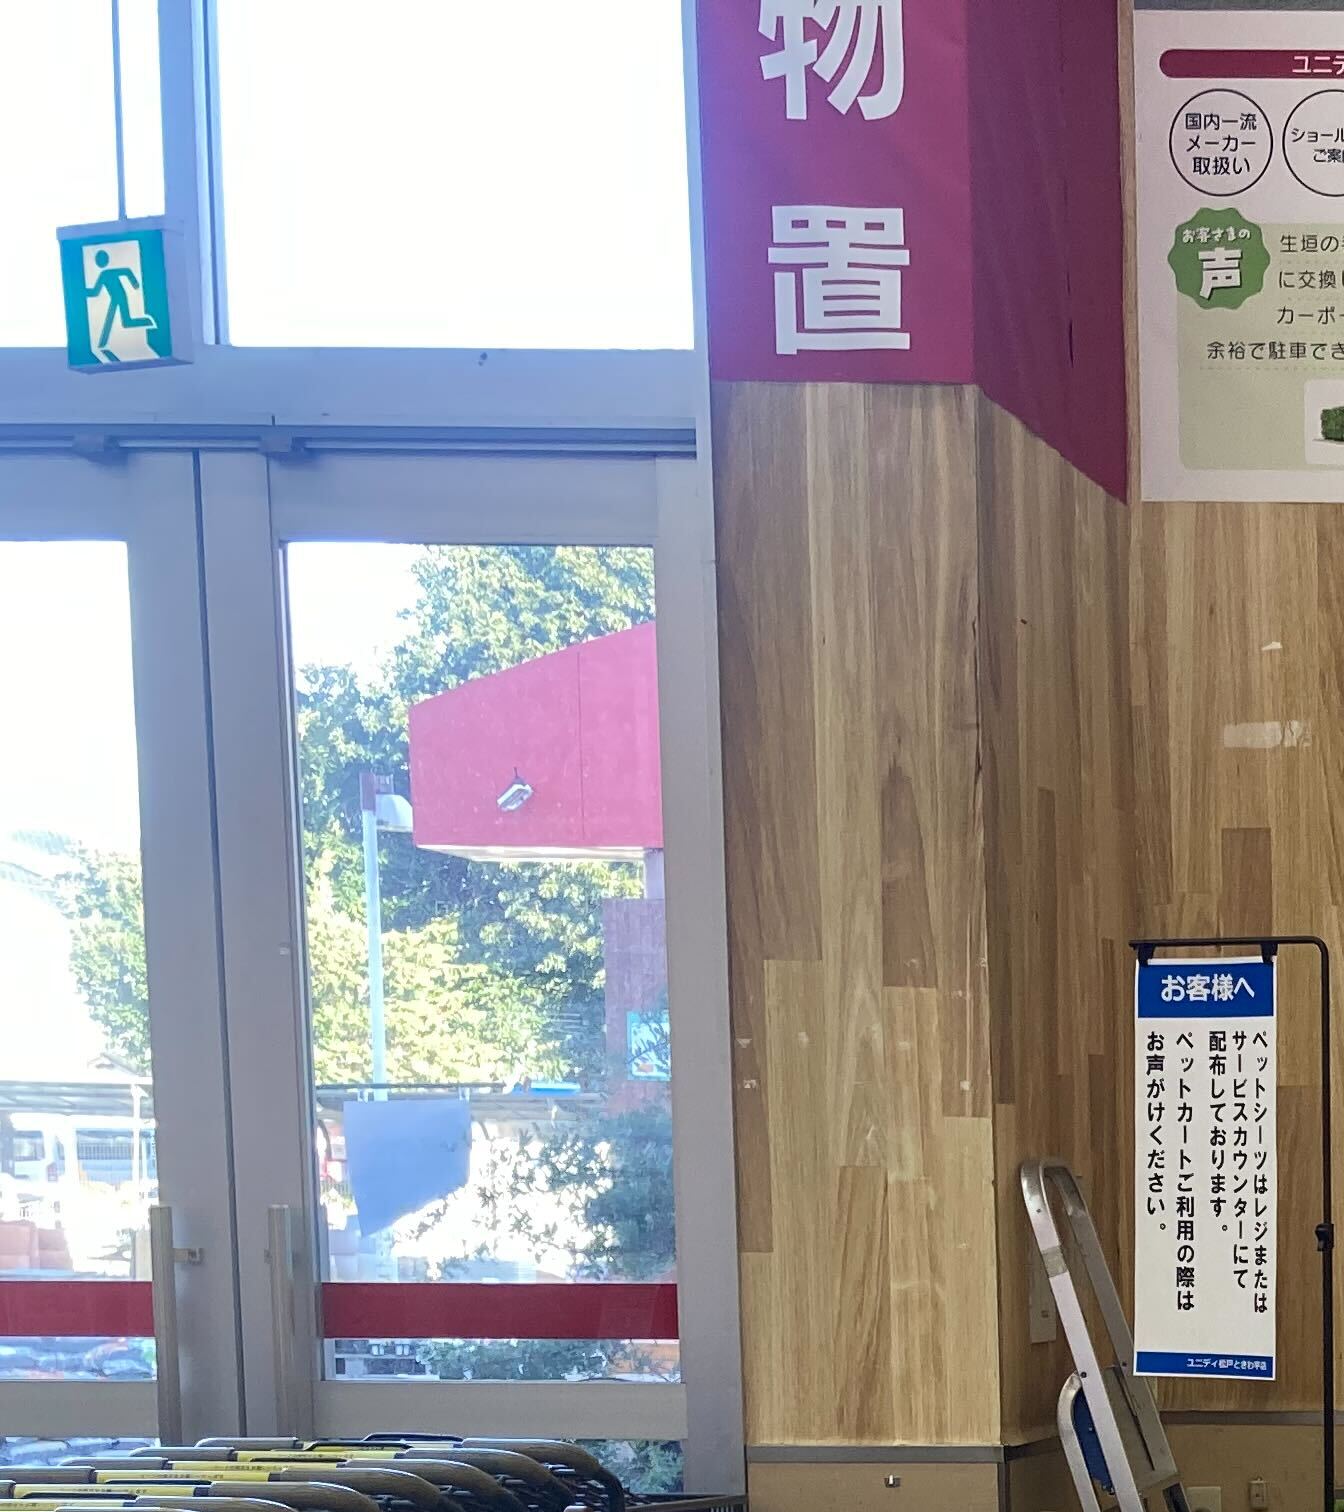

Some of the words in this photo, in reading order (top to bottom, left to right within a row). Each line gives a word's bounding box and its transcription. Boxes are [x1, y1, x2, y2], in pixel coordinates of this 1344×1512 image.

[1185, 113, 1257, 131] 国内一流
[1185, 136, 1256, 152] メーカー
[1192, 157, 1251, 176] 取扱い
[1182, 226, 1251, 243] お客さまの
[1197, 248, 1243, 299] 声
[1161, 974, 1255, 1003] お客様へ
[1146, 1031, 1166, 1231] お声がけください。
[1209, 1031, 1228, 1232] 配布しております。
[1176, 1031, 1194, 1310] ペットカートご利用の際は
[1232, 1031, 1249, 1290] サービスカウンターにて
[1252, 1031, 1268, 1313] ペットシーツはレジまたは
